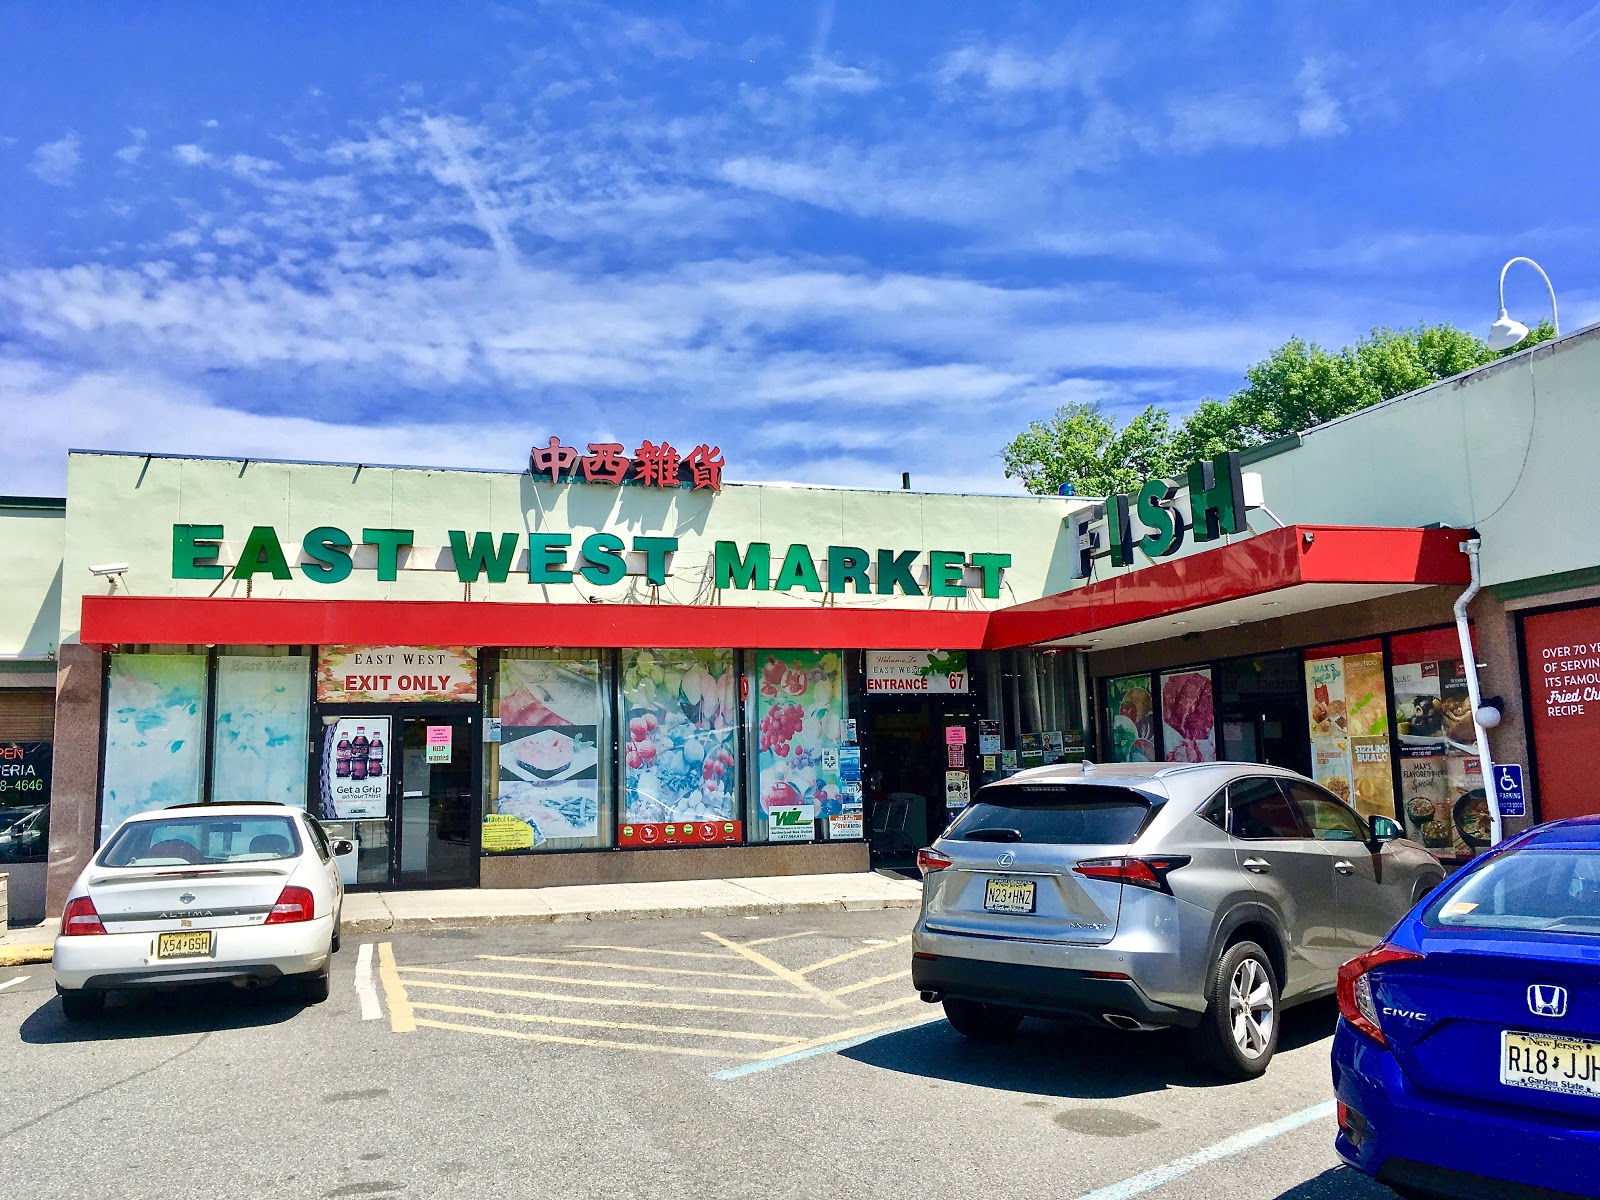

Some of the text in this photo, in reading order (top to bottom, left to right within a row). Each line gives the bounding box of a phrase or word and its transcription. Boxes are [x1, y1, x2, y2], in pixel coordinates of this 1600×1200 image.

[531, 436, 725, 492] 中西雜貨
[1068, 450, 1247, 580] FISH
[171, 523, 1012, 599] EAST WEST MARKET
[1542, 646, 1571, 659] OVER
[1573, 644, 1587, 655] 70
[355, 653, 447, 665] EAST WEST
[873, 666, 895, 674] EAST
[1543, 662, 1558, 673] OF
[345, 675, 451, 691] EXIT ONLY
[867, 678, 928, 690] ENTRANCE
[949, 673, 964, 689] 67
[1545, 676, 1562, 688] ITS
[1546, 688, 1581, 704] Fried
[1548, 704, 1585, 717] RECIPE
[1354, 744, 1389, 754] SIZZLING
[1356, 753, 1388, 763] BULALO
[0, 764, 36, 776] ERIA
[336, 786, 354, 794] Get
[362, 785, 382, 795] Grip
[158, 910, 213, 919] ALTIMA
[1382, 1006, 1427, 1021] CIVIC
[1529, 1037, 1584, 1052] New Jersey
[1527, 1076, 1584, 1091] Garden State
